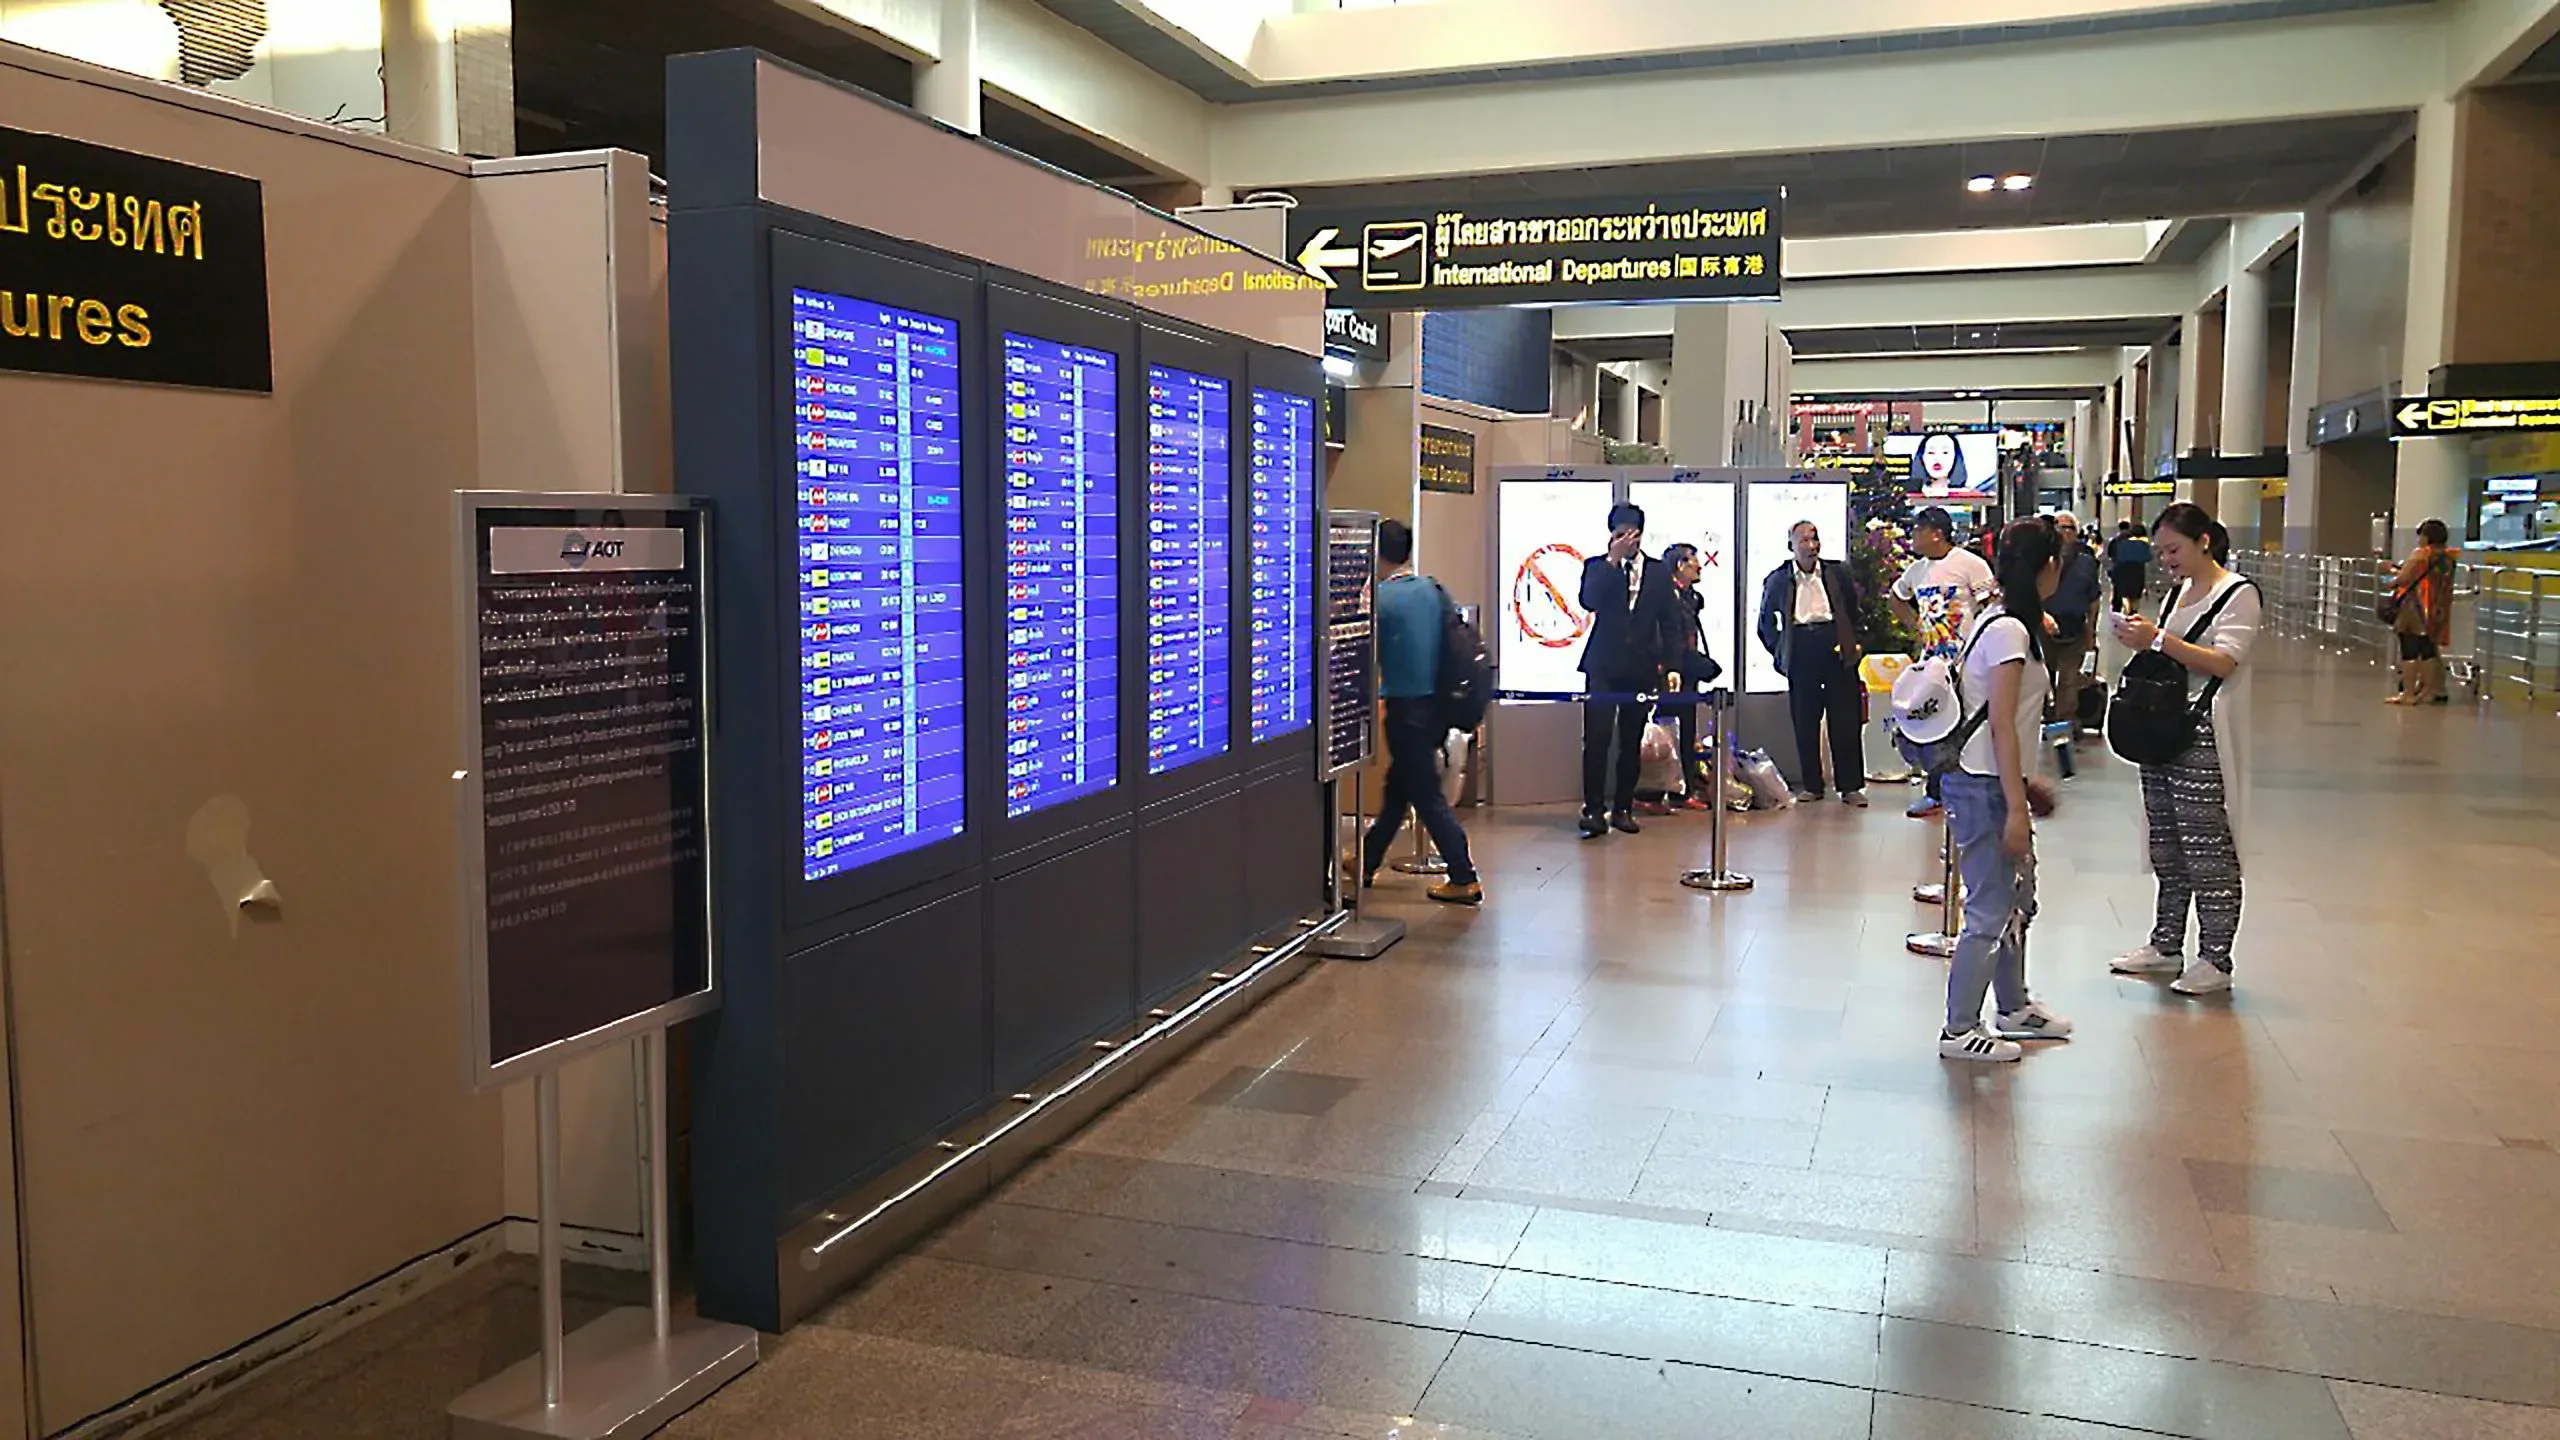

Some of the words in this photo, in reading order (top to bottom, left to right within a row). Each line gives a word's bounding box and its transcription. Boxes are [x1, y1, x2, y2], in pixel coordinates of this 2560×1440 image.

[1433, 259, 1553, 286] International
[1562, 256, 1671, 286] Departures
[0, 290, 152, 348] ures
[591, 540, 624, 559] AOT
